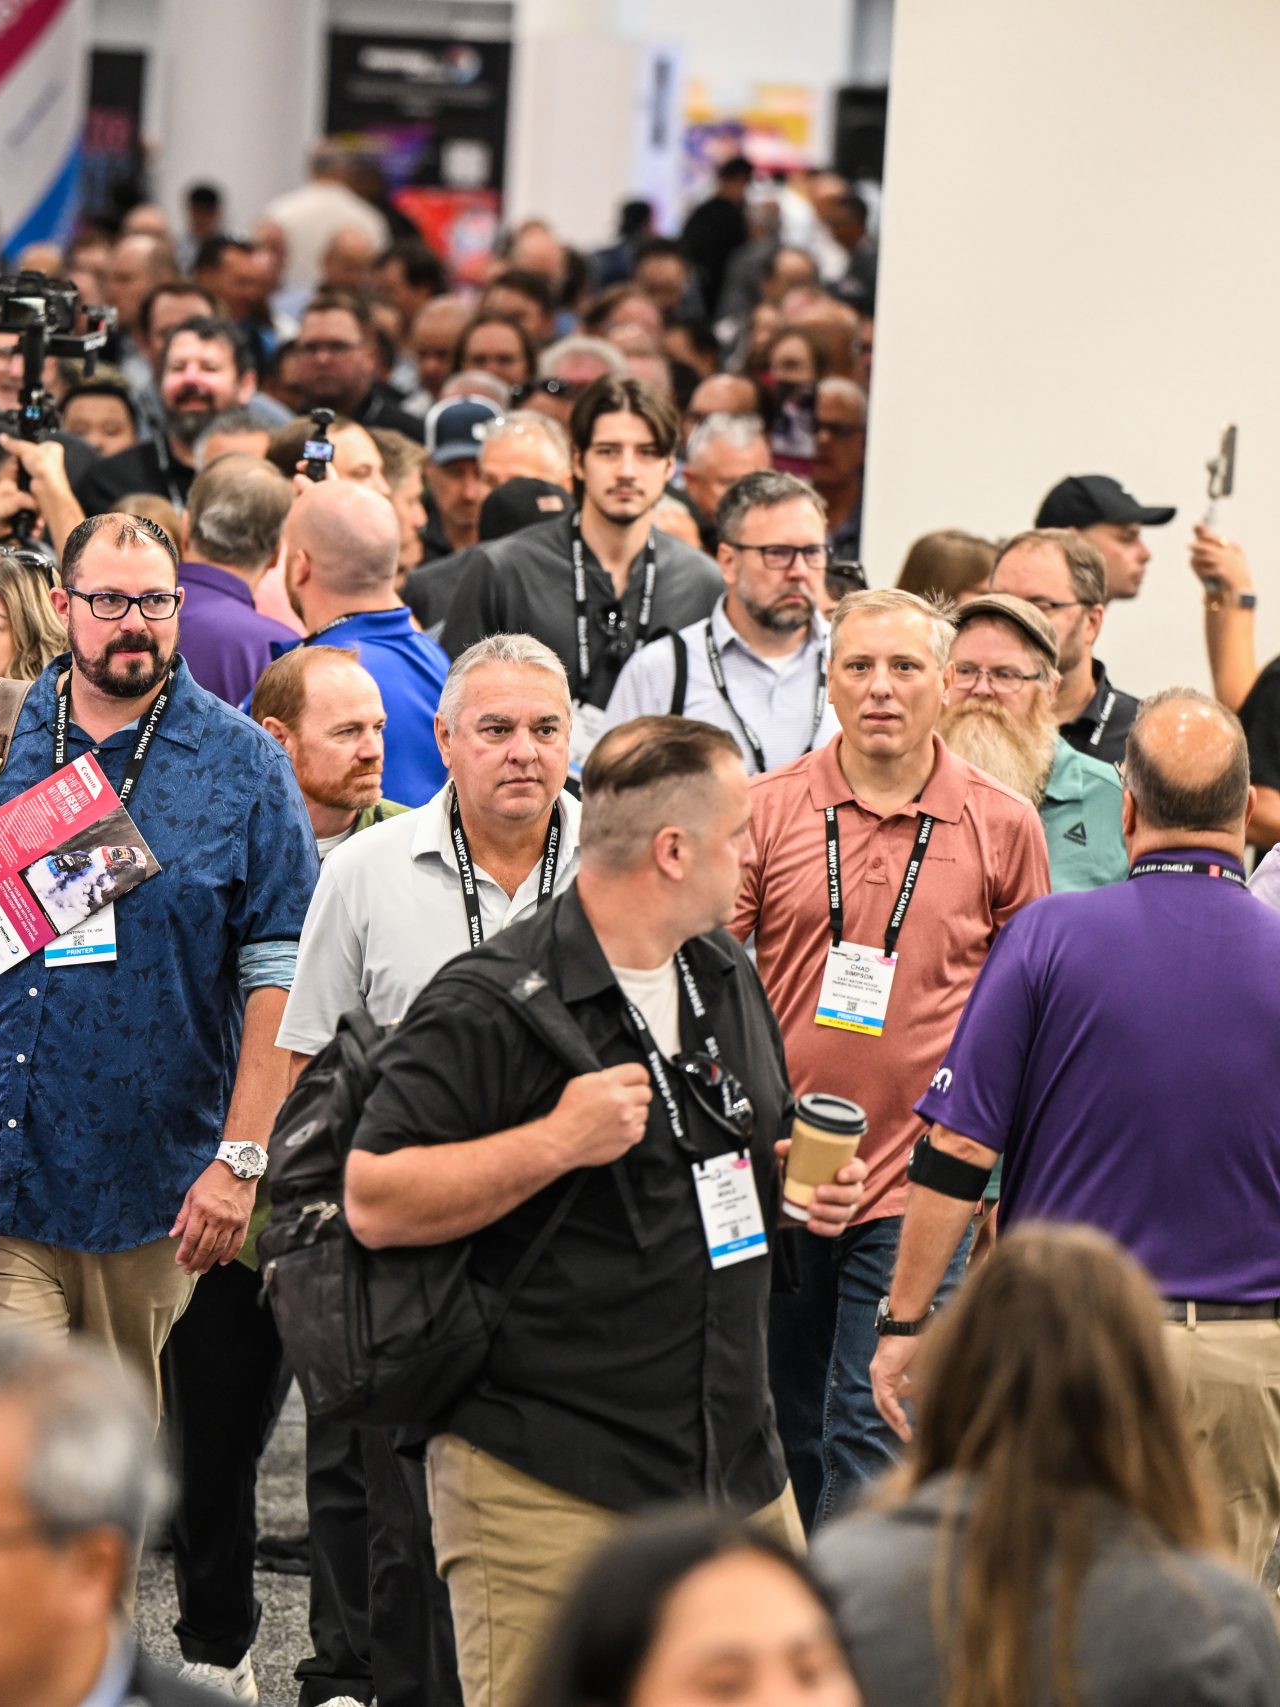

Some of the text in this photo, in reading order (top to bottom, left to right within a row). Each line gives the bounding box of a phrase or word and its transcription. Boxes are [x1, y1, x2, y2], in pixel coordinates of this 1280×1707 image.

[55, 695, 67, 763] BELLA+CANVAS
[134, 694, 167, 760] BELLA+CANVAS
[54, 778, 82, 814] HIGH GEAR
[63, 772, 91, 807] SHIFT INTO
[81, 766, 96, 789] Canon
[45, 784, 76, 825] WITH CANON
[453, 826, 474, 895] BELLA+CANVAS
[542, 826, 558, 895] BELLA+CANVAS
[828, 839, 840, 909] BELLA+CANVAS
[1162, 864, 1193, 873] GMELIN
[891, 860, 919, 928] BELLA+CANVAS
[845, 970, 873, 980] SIMPSON
[851, 964, 870, 973] CHAD
[837, 1012, 864, 1023] PRINTER
